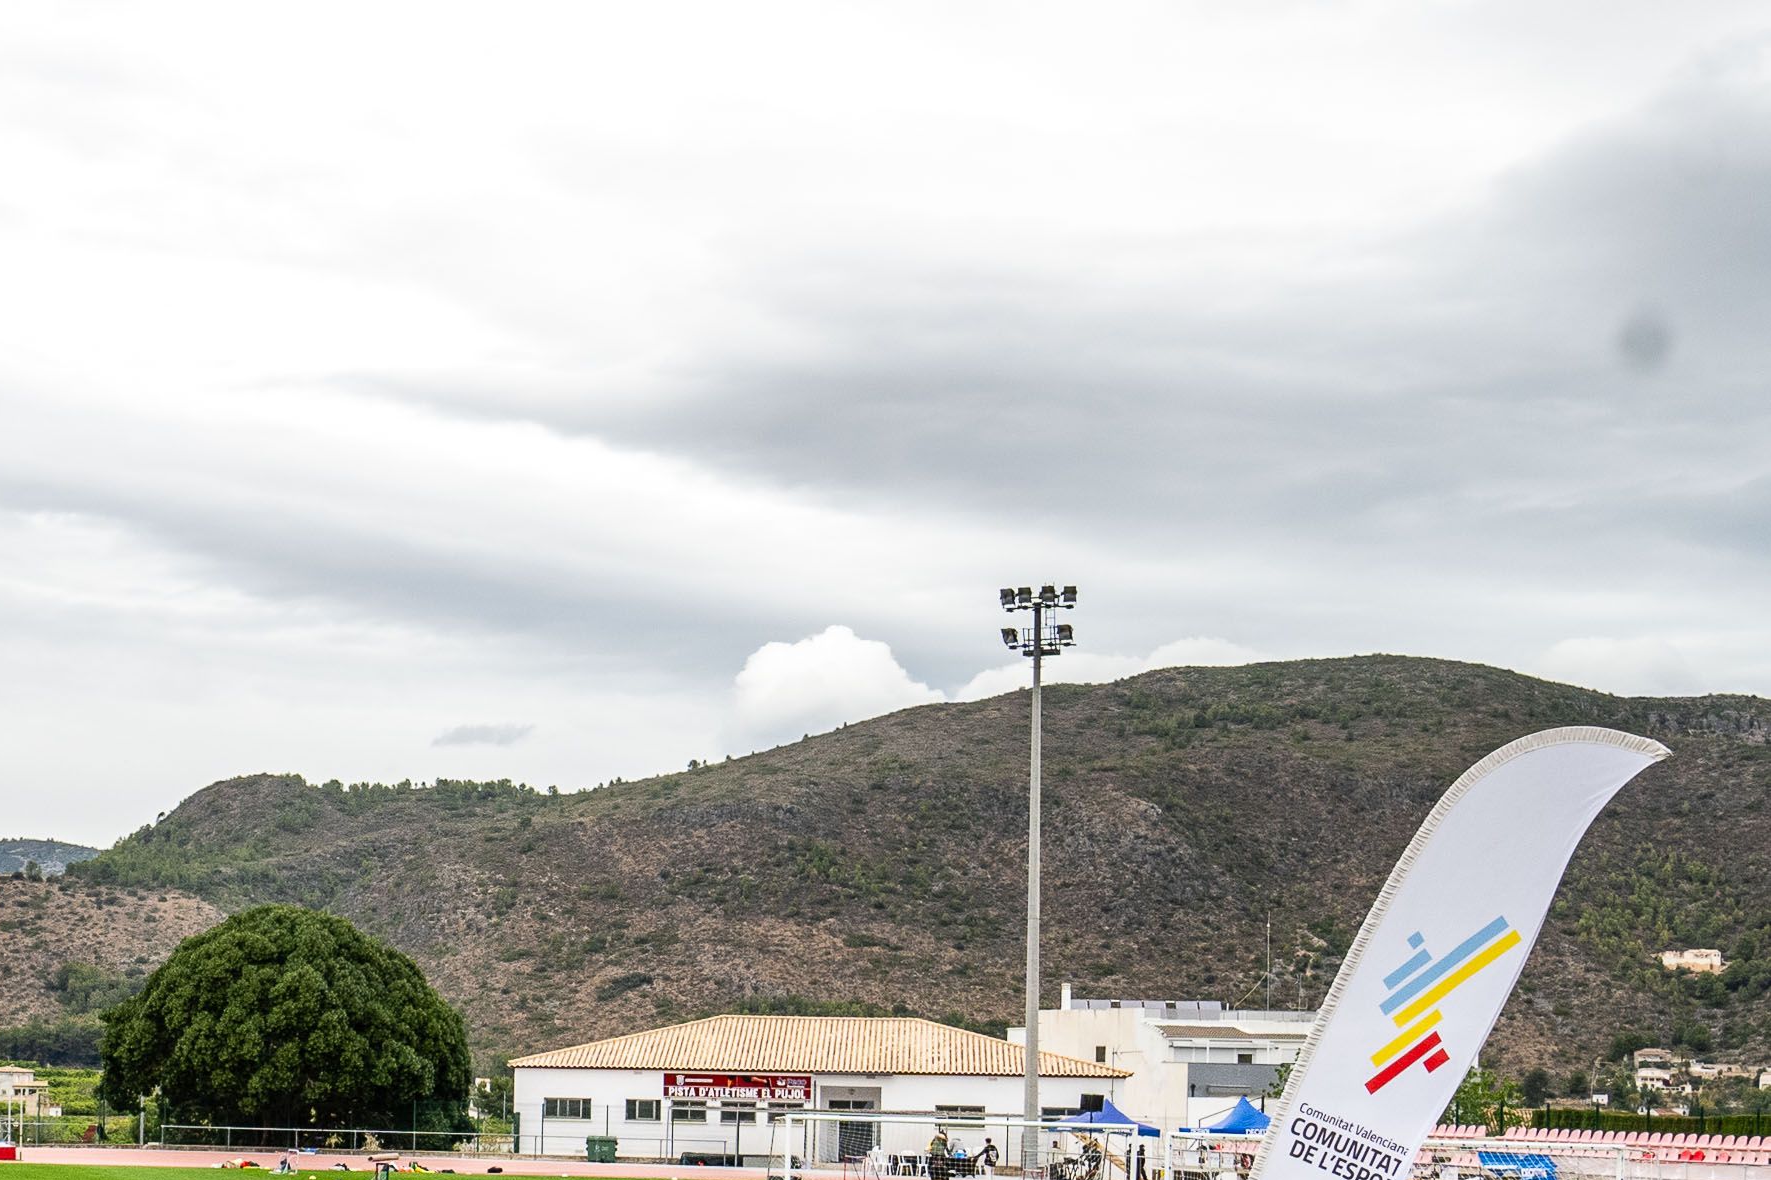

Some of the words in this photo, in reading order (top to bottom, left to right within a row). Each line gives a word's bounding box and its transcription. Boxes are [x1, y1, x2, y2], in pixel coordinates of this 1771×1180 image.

[668, 1087, 696, 1097] PISTA
[698, 1087, 759, 1099] D'ATLETISME
[761, 1088, 772, 1099] EL
[775, 1088, 806, 1100] PUJOL
[1299, 1102, 1355, 1133] Comunitat
[1289, 1139, 1318, 1164] DE
[1290, 1117, 1403, 1177] COMUNITAT
